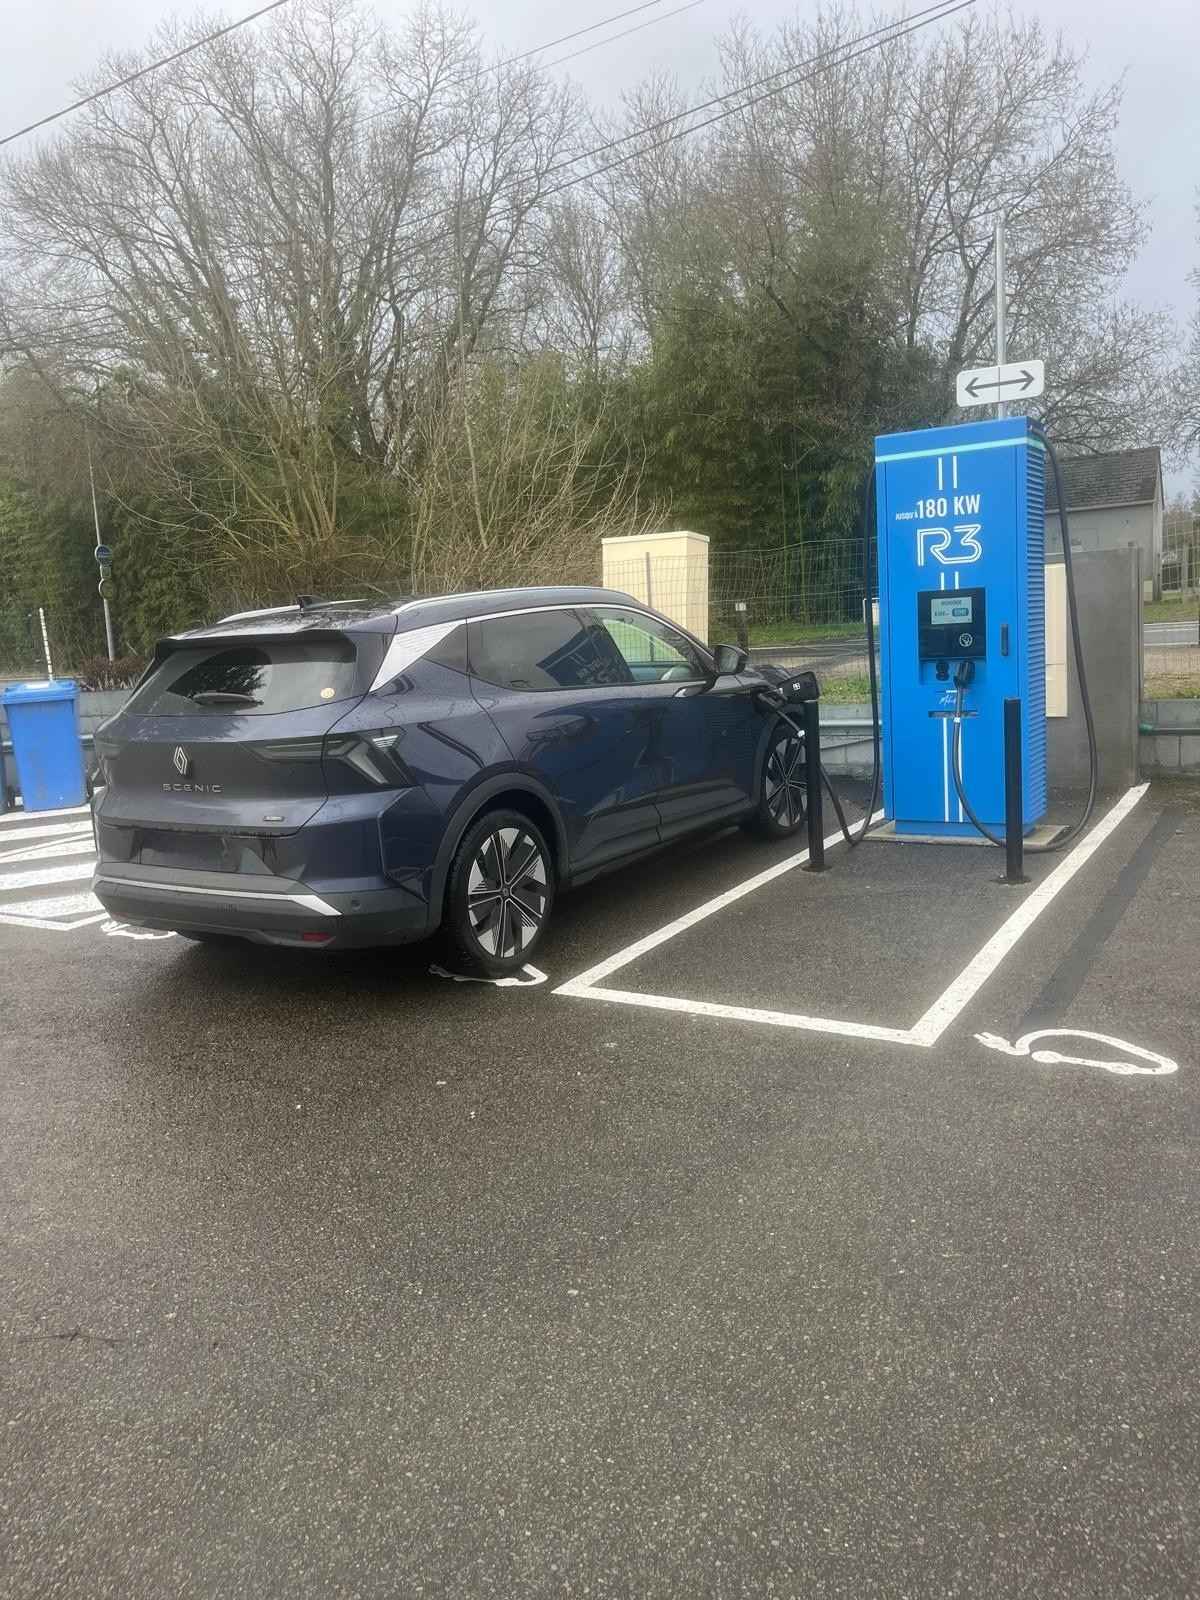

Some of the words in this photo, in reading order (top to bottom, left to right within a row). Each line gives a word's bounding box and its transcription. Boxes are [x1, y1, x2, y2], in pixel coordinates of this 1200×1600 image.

[916, 497, 948, 519] 180
[953, 494, 981, 515] KW
[916, 523, 983, 567] R3
[162, 783, 223, 793] SCENIC
